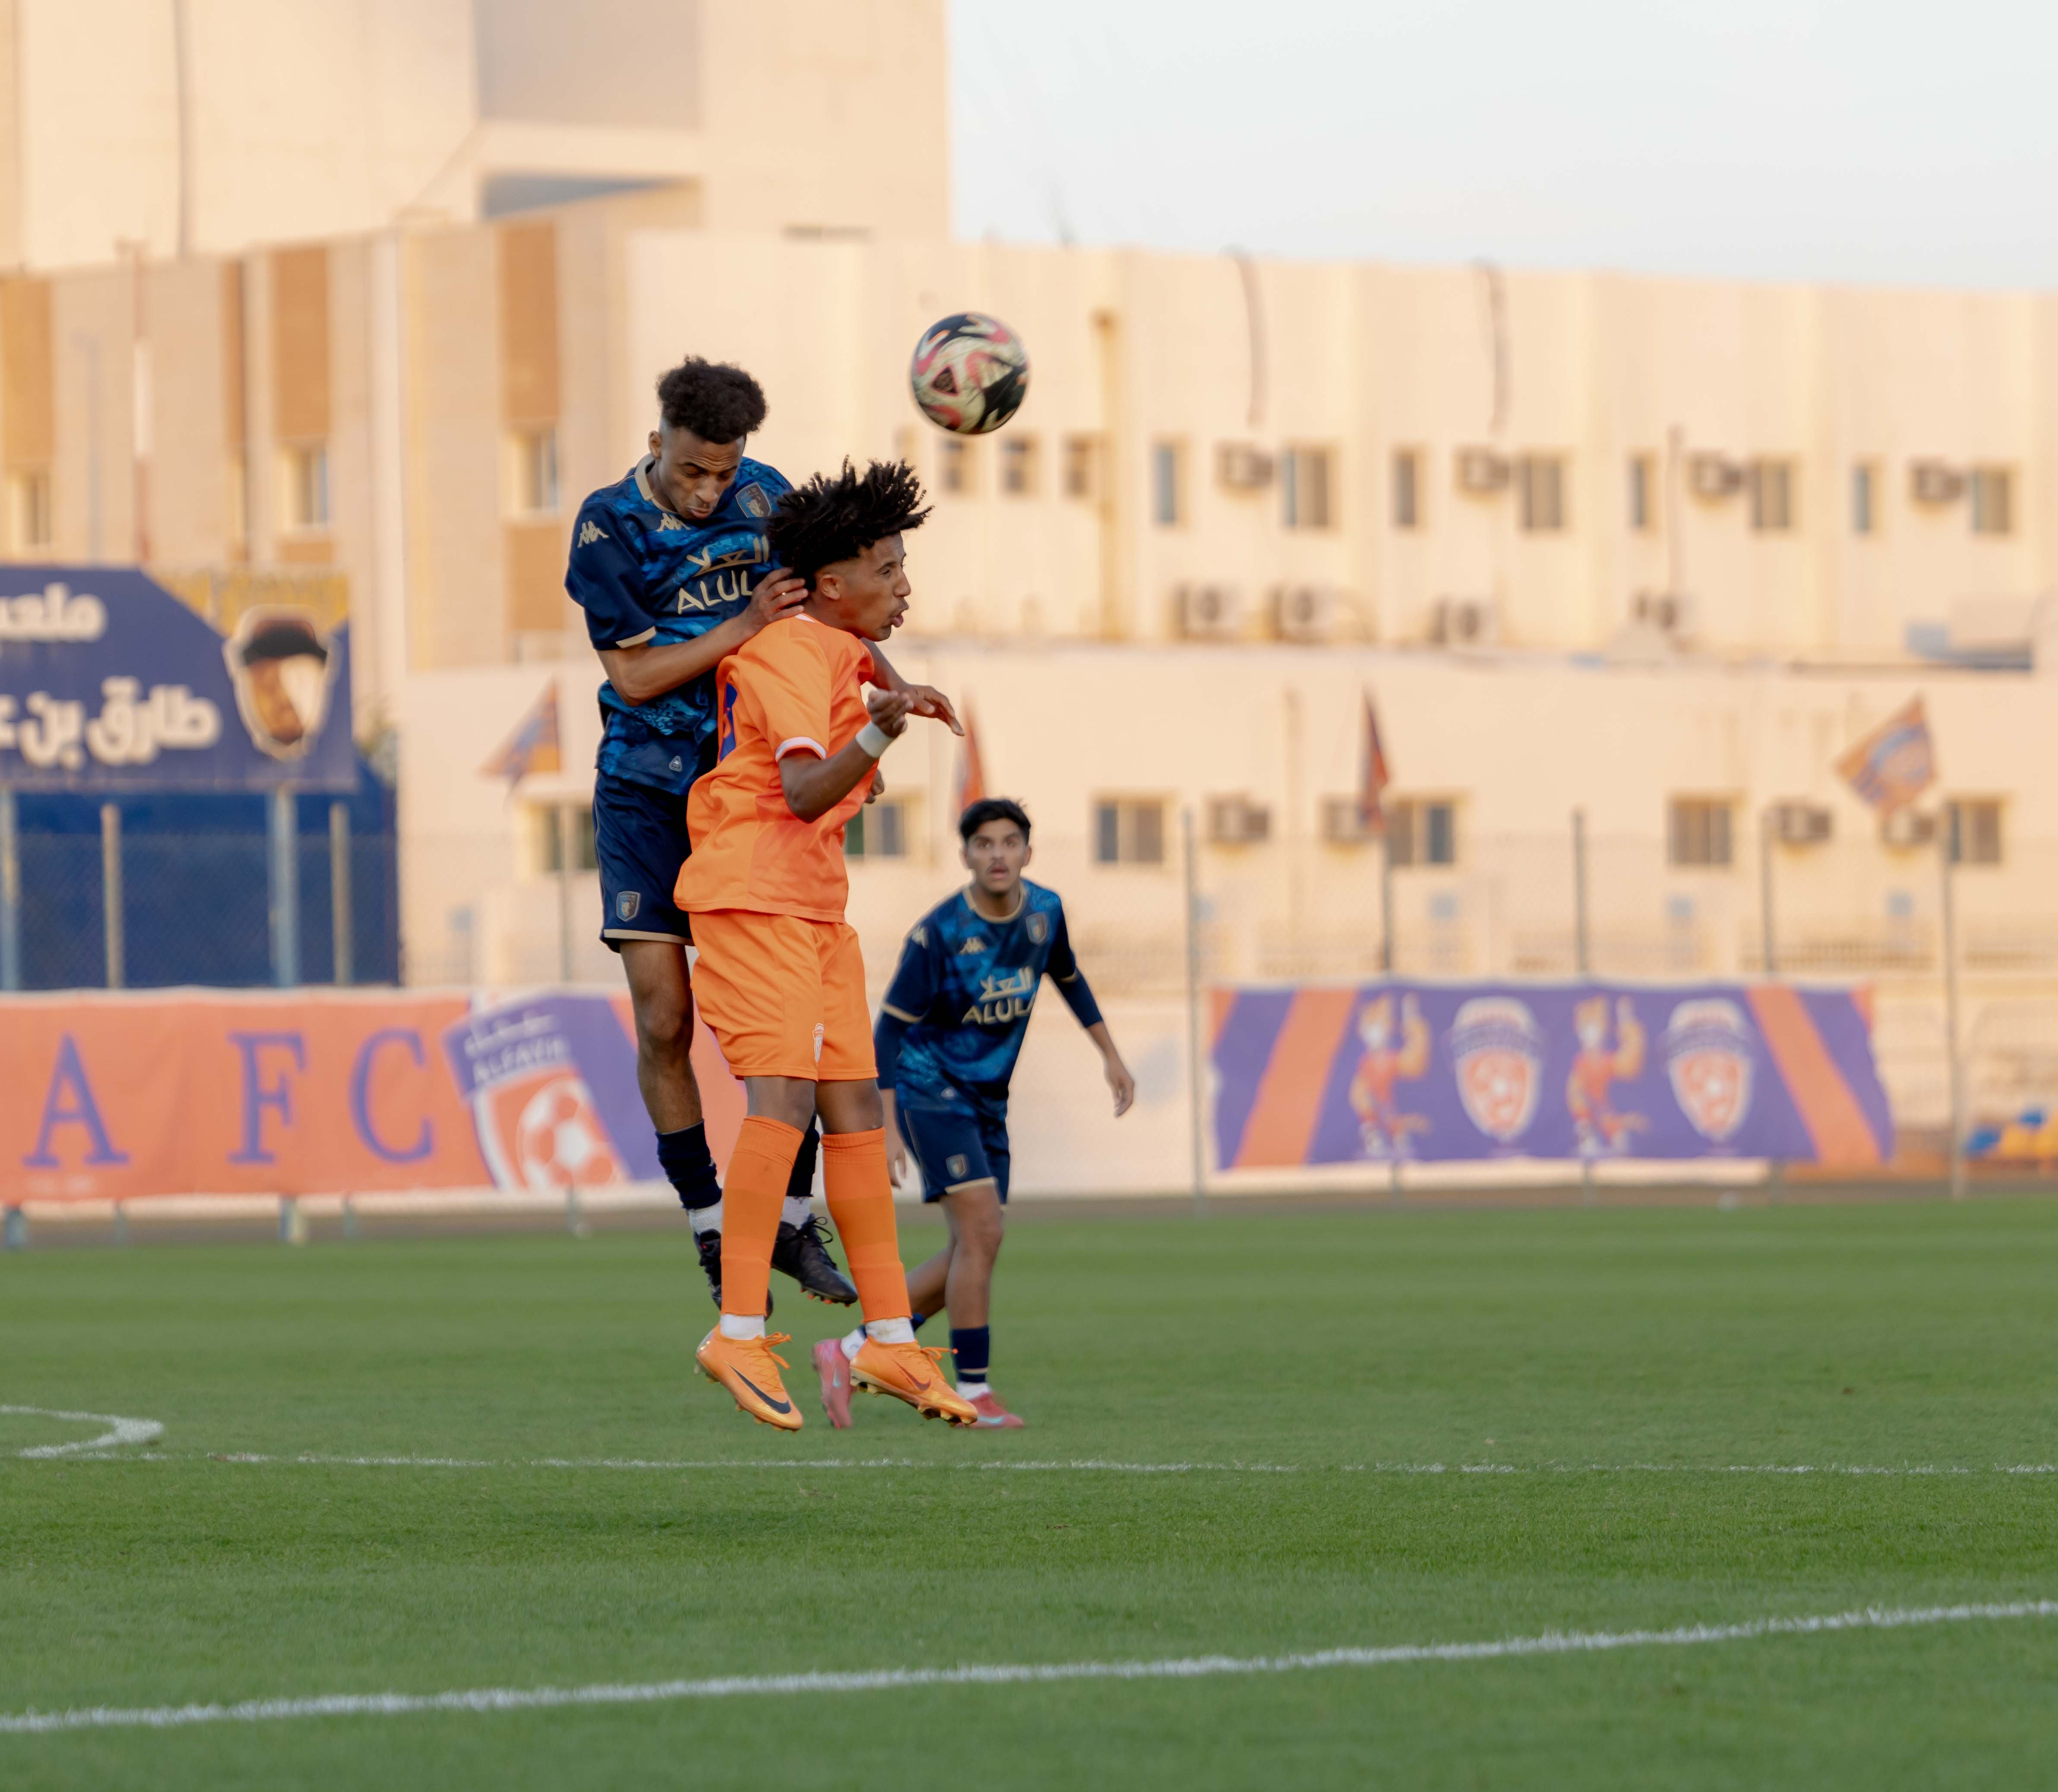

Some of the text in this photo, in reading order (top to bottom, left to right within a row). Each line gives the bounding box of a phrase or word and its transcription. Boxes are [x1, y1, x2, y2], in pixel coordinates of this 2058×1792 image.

[677, 570, 753, 615] ALUL
[19, 691, 86, 771] بن
[88, 676, 222, 765] طارق
